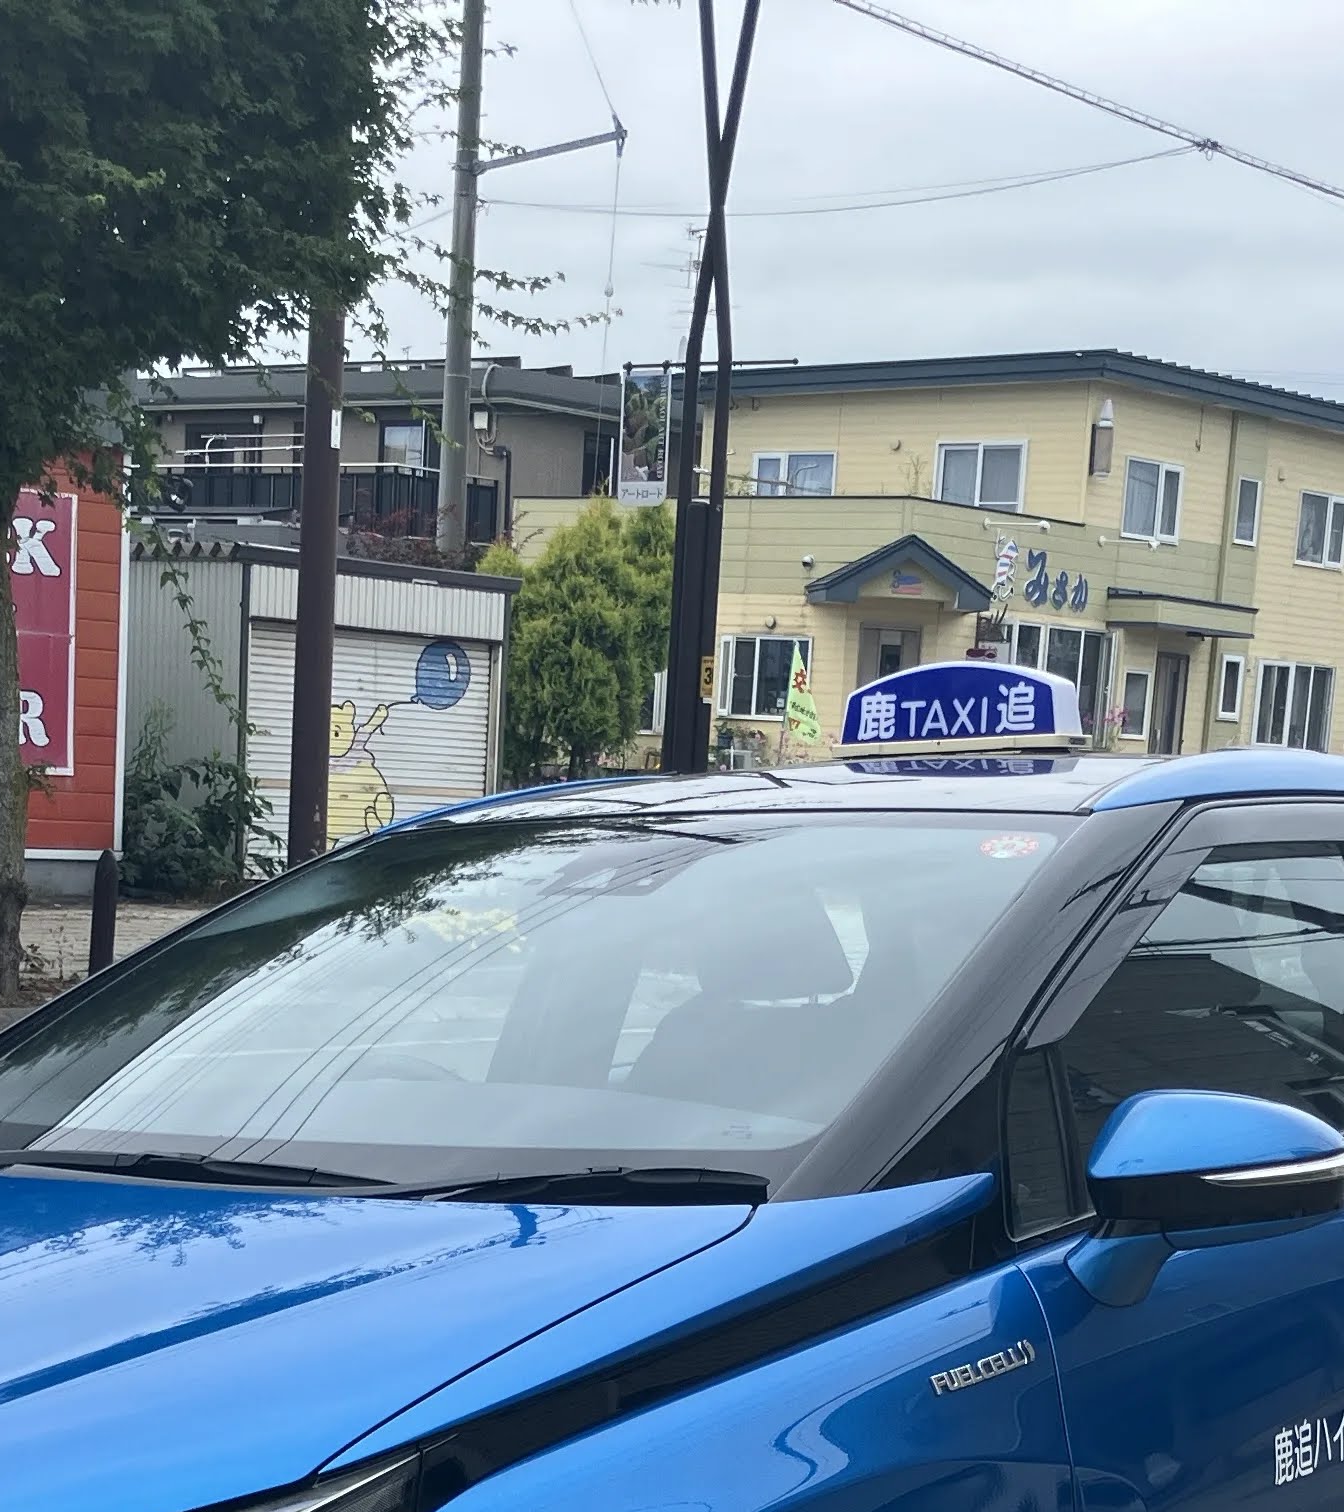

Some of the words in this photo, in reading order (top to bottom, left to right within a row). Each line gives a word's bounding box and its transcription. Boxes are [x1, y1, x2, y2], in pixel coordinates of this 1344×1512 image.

[656, 449, 664, 479] ROAD
[621, 488, 664, 499] アートロード
